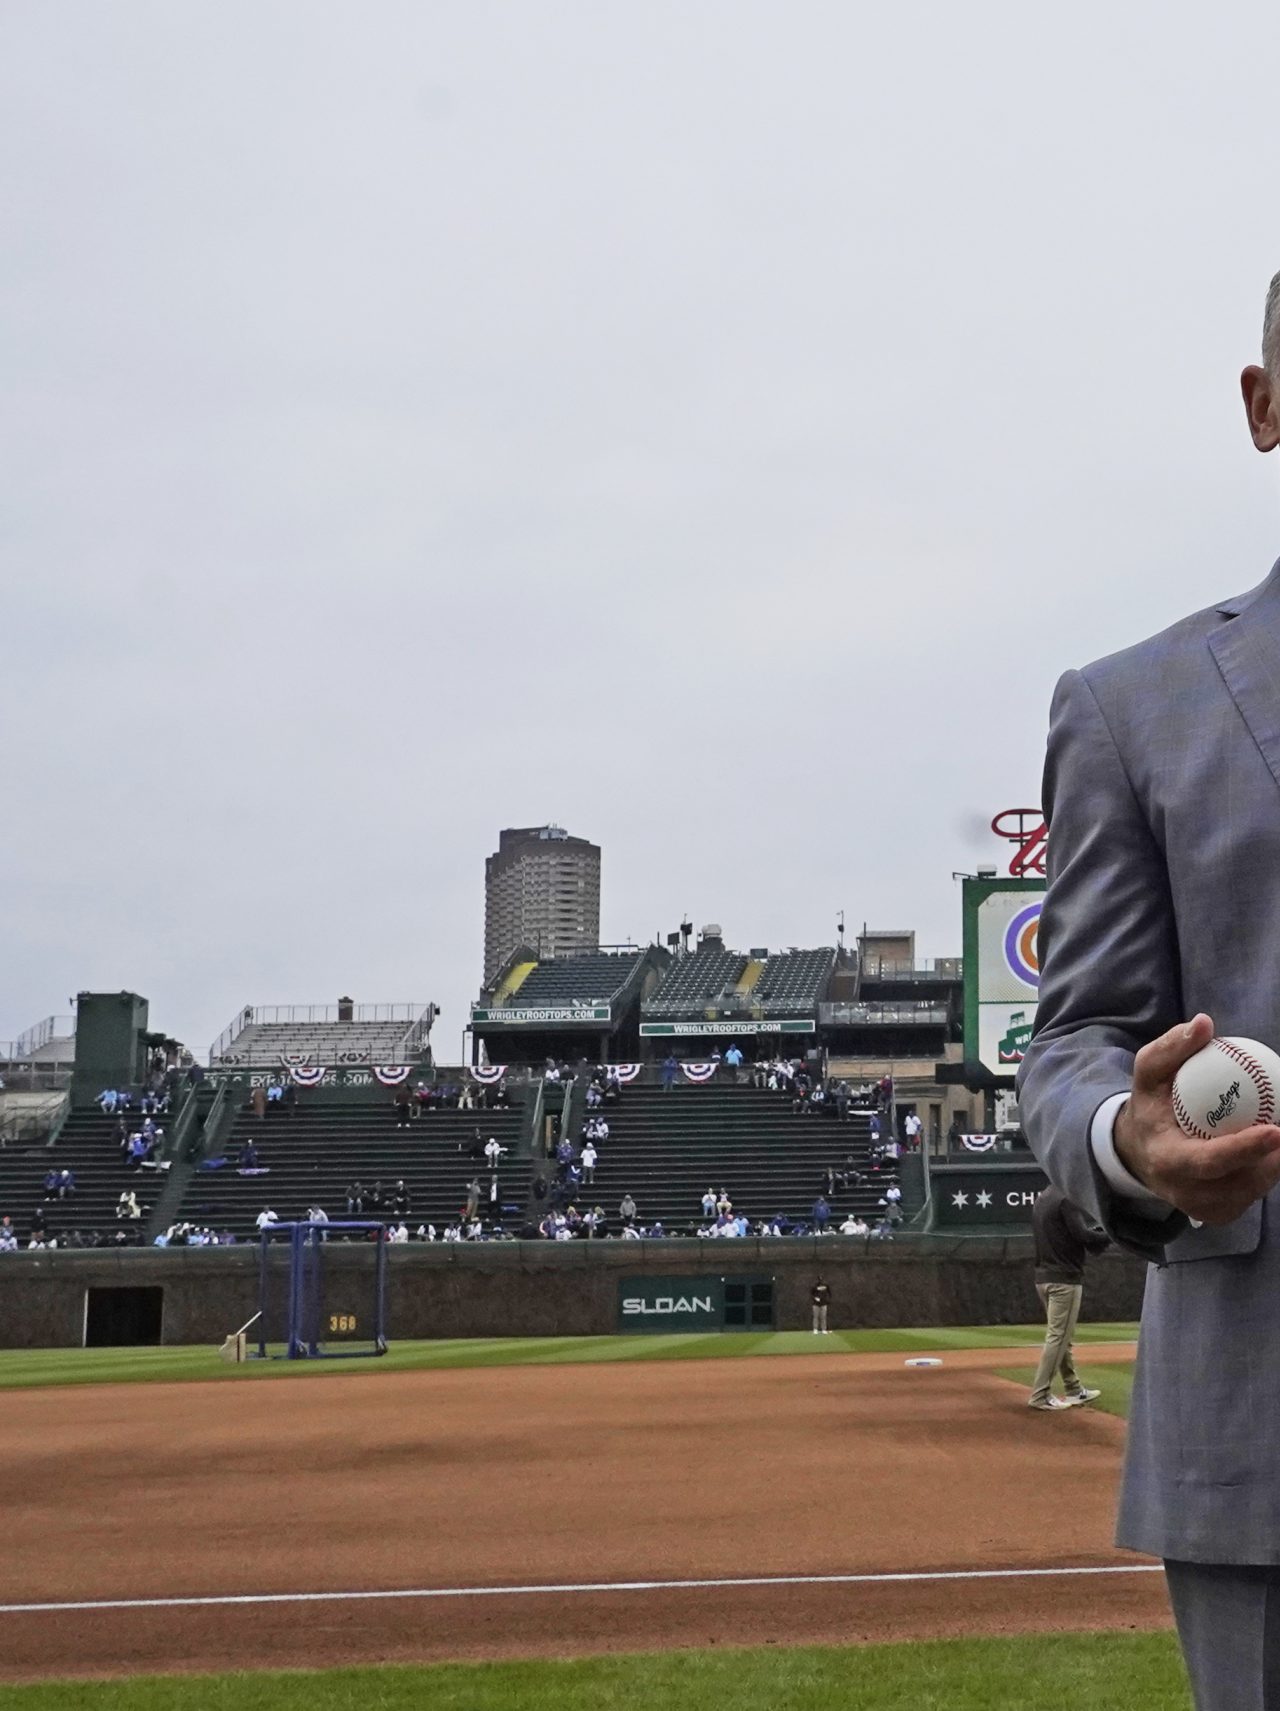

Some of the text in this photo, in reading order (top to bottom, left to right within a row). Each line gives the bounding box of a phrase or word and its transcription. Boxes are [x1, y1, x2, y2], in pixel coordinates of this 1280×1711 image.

[487, 1010, 595, 1020] WRIGLEYROOFTOPS.COM
[673, 1023, 782, 1033] WRIGLEYROOFTOPS.COM
[1206, 1080, 1241, 1128] Rawlings
[1006, 1191, 1041, 1206] CH
